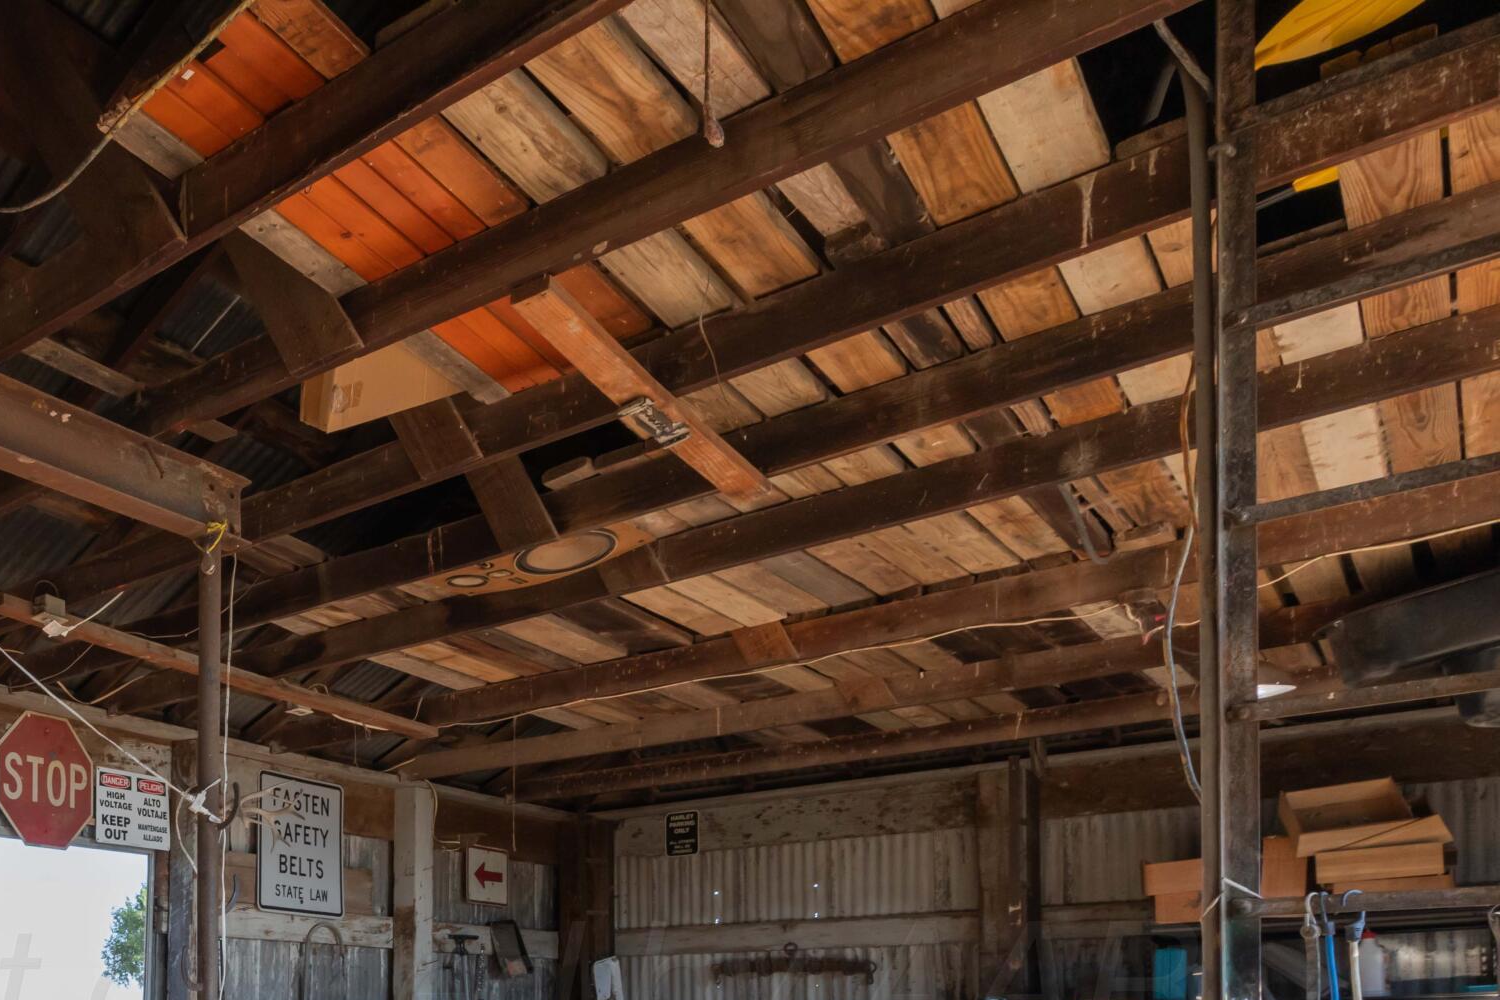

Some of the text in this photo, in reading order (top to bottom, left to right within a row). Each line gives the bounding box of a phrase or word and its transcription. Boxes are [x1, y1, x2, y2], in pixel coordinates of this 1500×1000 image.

[3, 751, 88, 809] STOP
[102, 775, 129, 788] DANGER
[139, 782, 165, 793] PELIGRO
[106, 791, 126, 800] HIGH
[273, 787, 330, 817] FASTEN
[99, 799, 133, 811] VOLTAGE
[143, 797, 161, 808] ALTO
[137, 807, 168, 820] VOLTAJE
[101, 813, 131, 828] KEEP
[669, 820, 695, 828] PARKING
[104, 828, 128, 841] OUT
[279, 853, 324, 880] BELTS
[275, 884, 328, 903] STATE LAW
